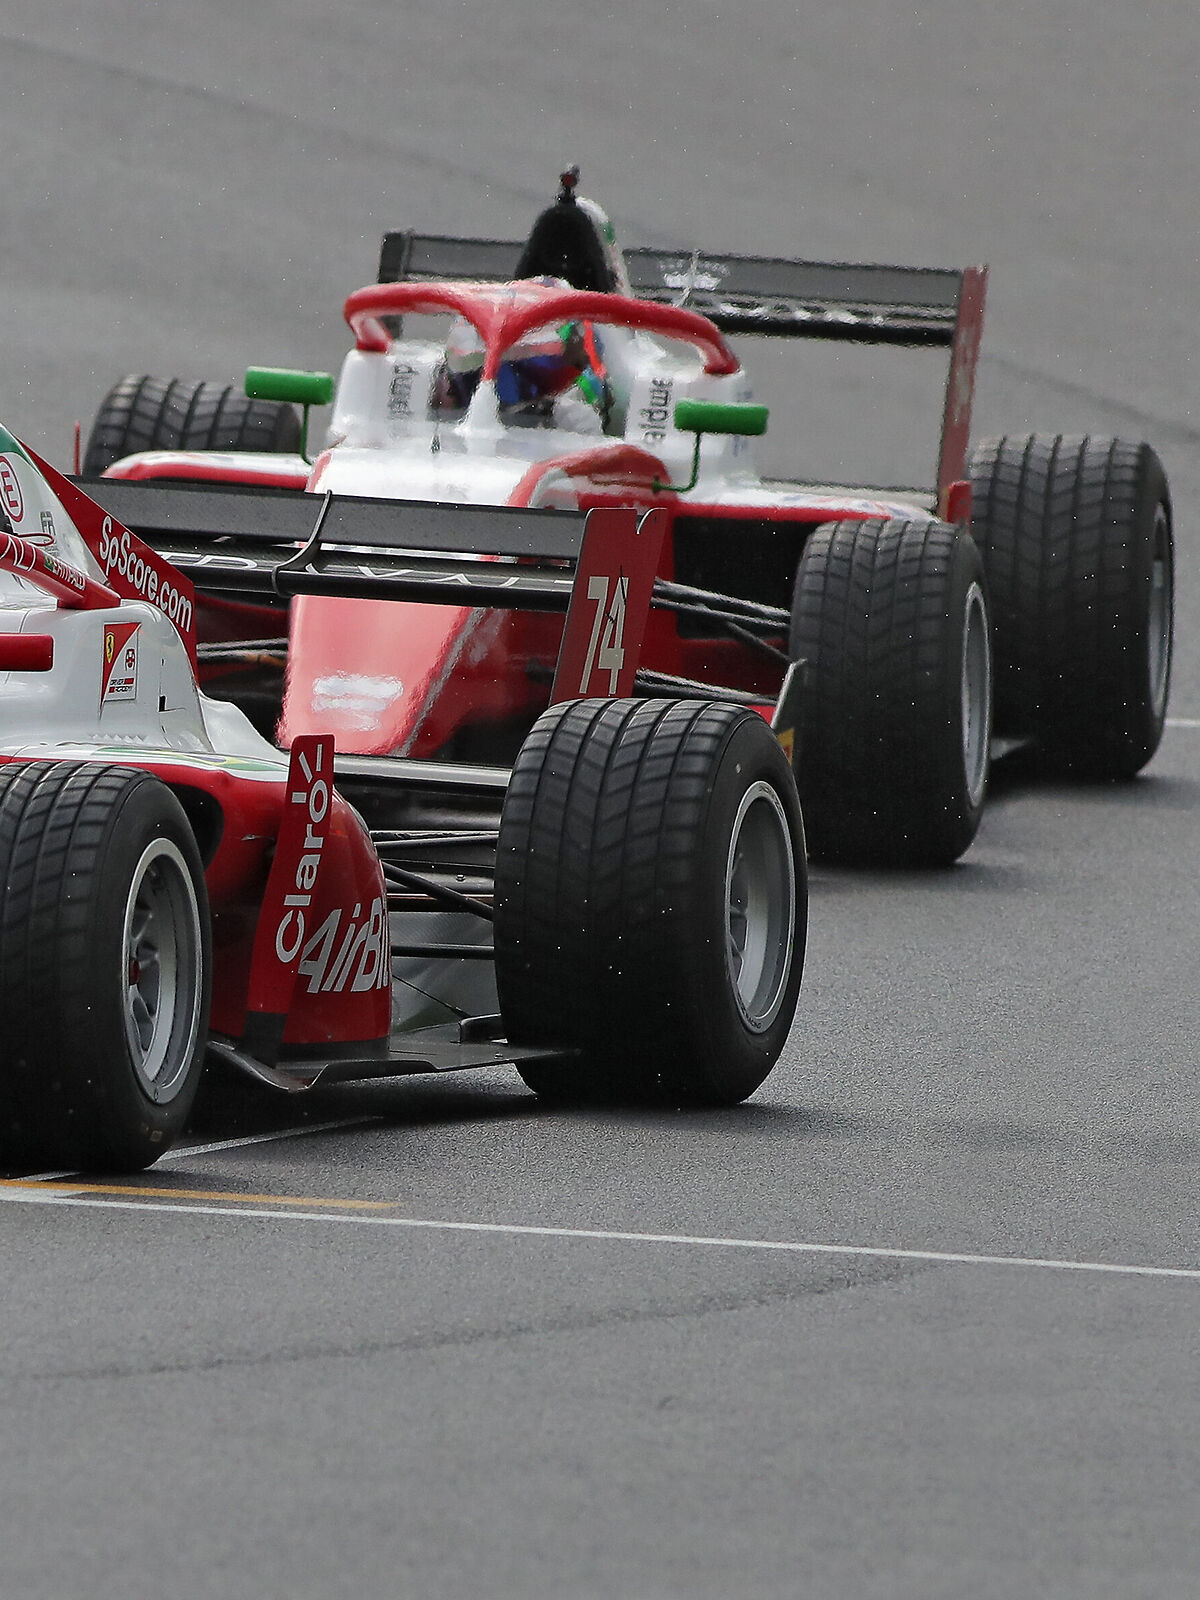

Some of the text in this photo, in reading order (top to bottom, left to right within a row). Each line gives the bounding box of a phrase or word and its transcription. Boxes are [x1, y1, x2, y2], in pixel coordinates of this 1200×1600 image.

[99, 515, 193, 632] SpScore.com
[579, 576, 629, 694] 74
[275, 779, 329, 963] Claro
